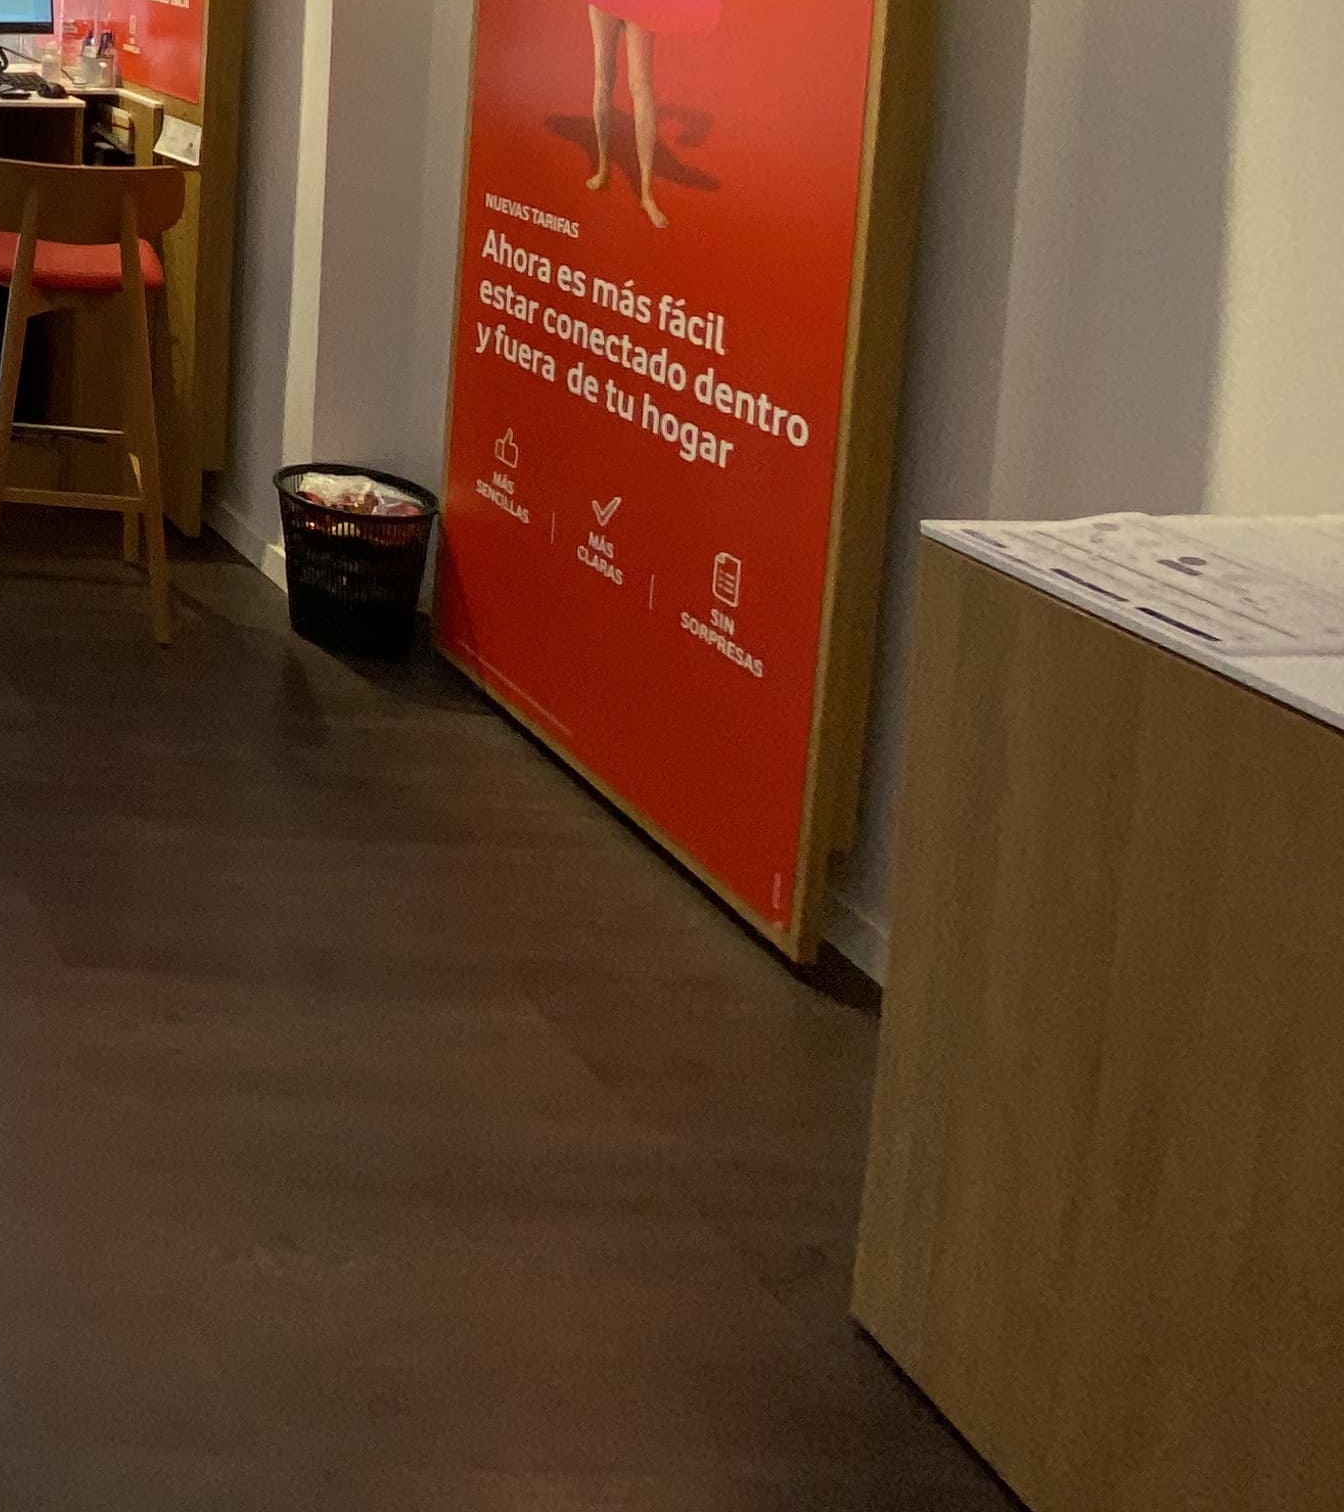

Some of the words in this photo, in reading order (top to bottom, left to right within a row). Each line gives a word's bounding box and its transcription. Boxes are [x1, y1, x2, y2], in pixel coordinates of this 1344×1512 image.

[485, 193, 530, 222] NUEVAS
[531, 208, 580, 238] TARIFAS
[482, 229, 551, 284] Ahora
[557, 264, 586, 298] es
[592, 280, 651, 324] más
[659, 294, 726, 356] fácil
[479, 279, 539, 324] estar
[543, 307, 687, 391] conectado
[695, 368, 809, 448] dentro
[476, 322, 491, 354] y
[494, 325, 556, 382] fuera
[567, 362, 600, 404] de
[605, 379, 634, 422] tu
[641, 393, 734, 469] hogar
[476, 479, 529, 524] SENCILLAS
[493, 471, 515, 495] MÁS
[576, 545, 623, 586] CLARAS
[588, 531, 614, 559] MÁS
[680, 611, 763, 678] SORPRESAS
[710, 608, 735, 636] SIN
